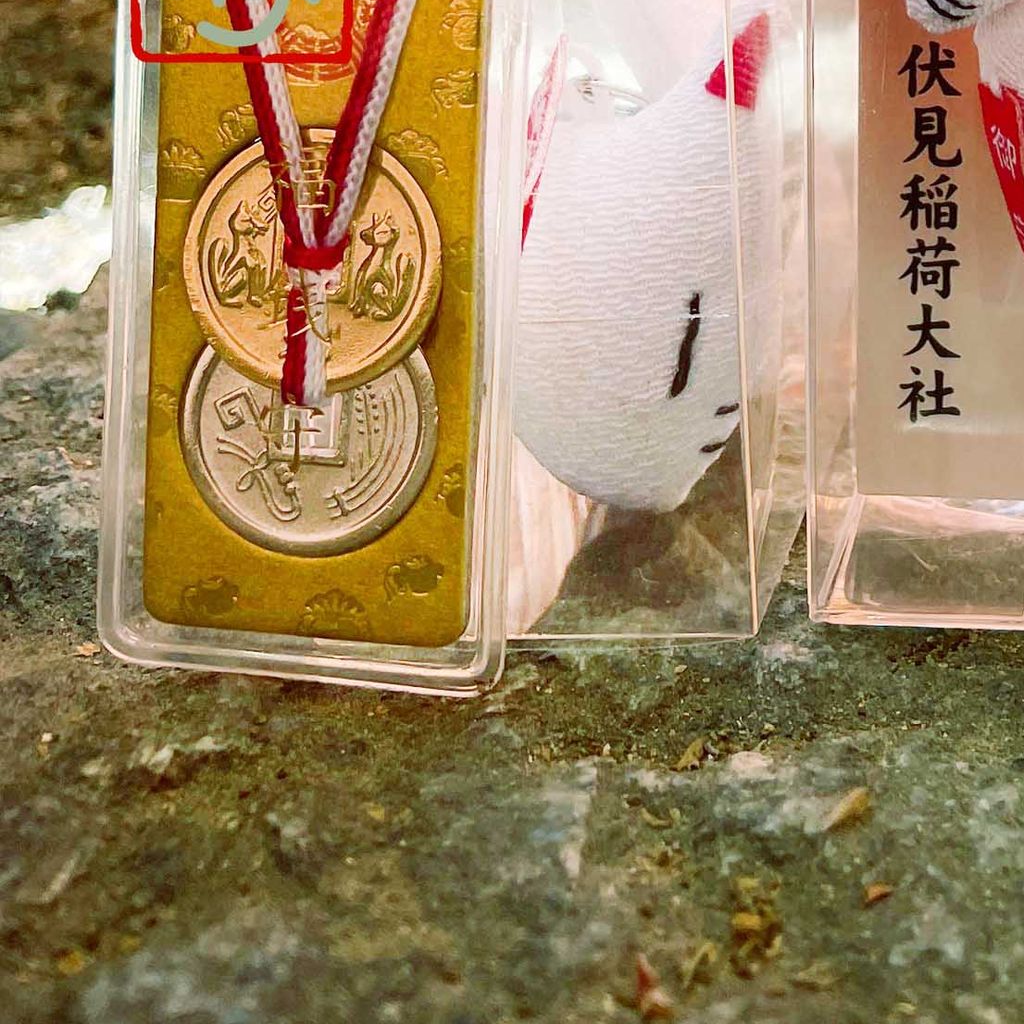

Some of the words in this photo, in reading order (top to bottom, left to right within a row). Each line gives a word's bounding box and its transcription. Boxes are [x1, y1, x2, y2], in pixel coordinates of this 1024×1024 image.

[897, 41, 963, 424] 伏見稲荷大社
